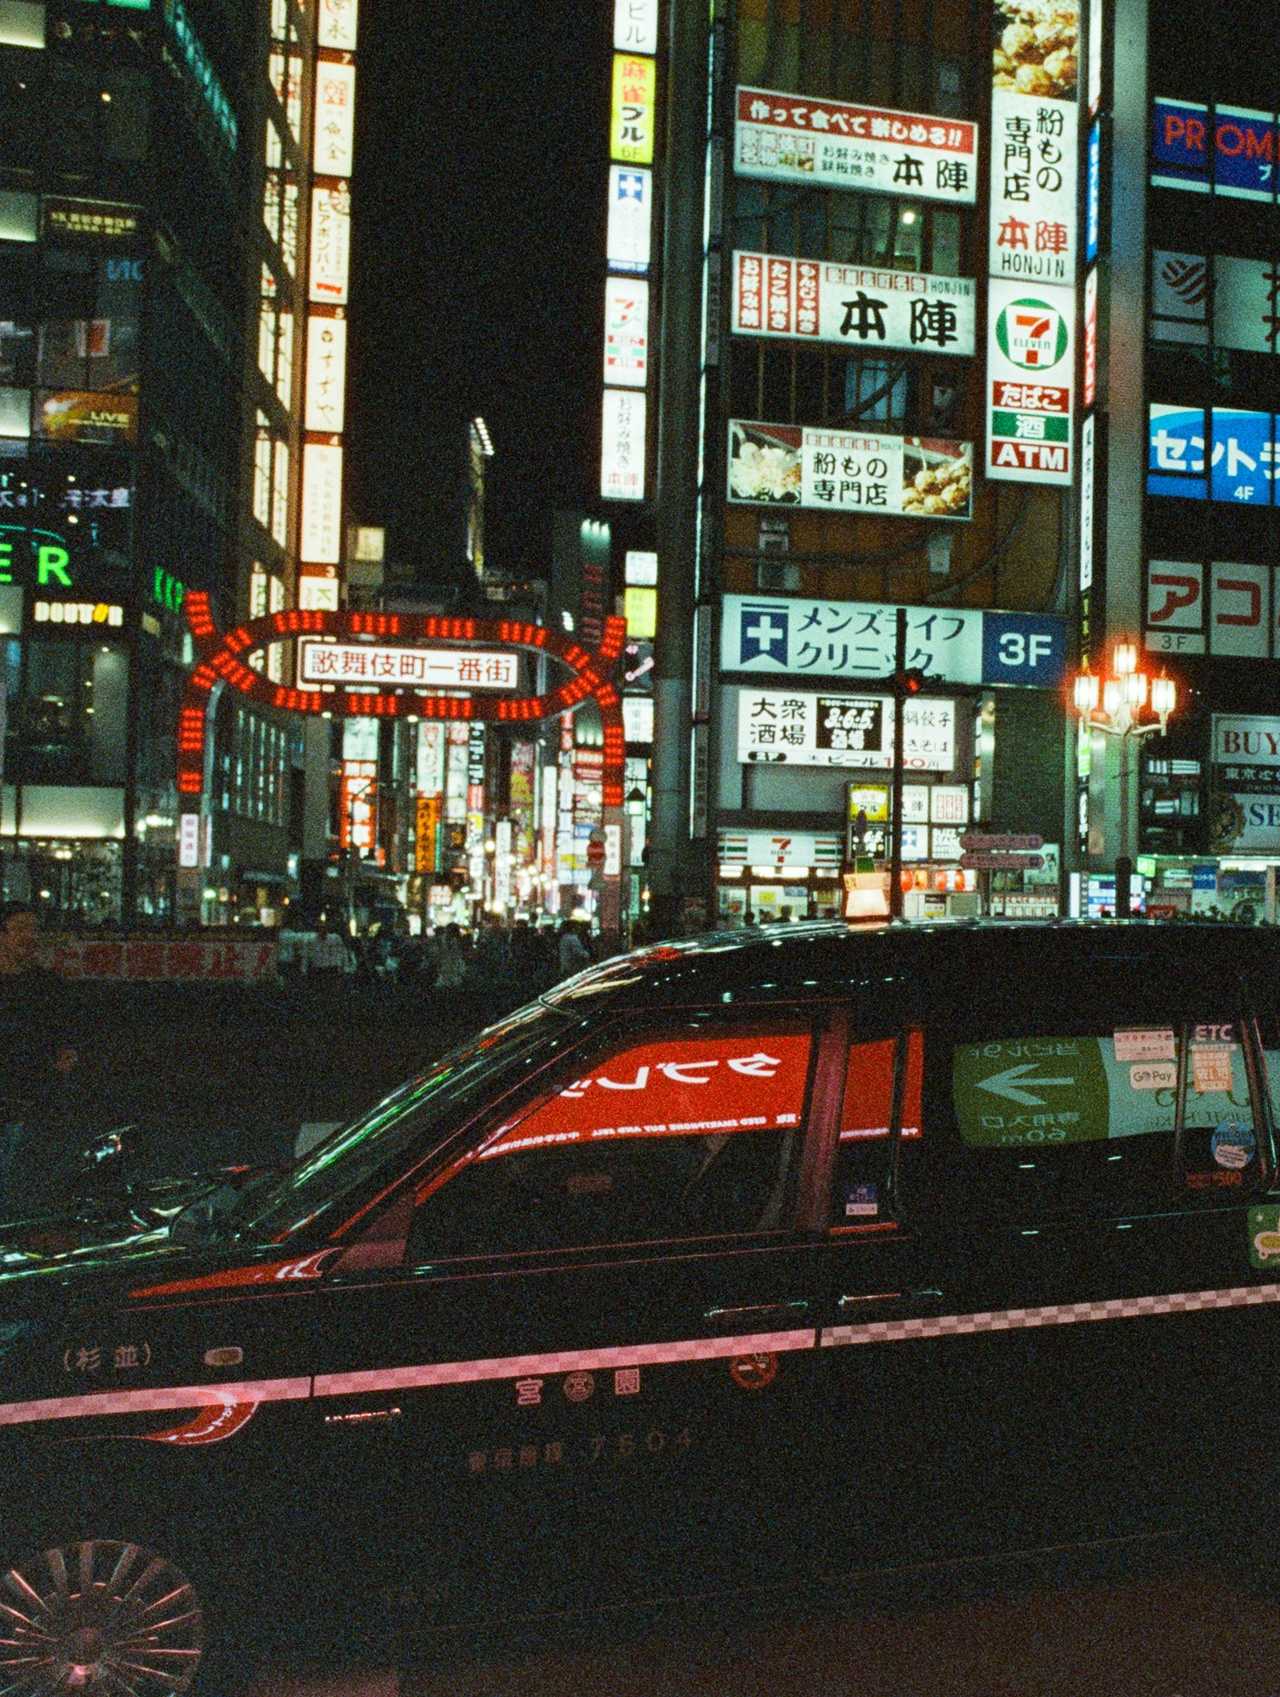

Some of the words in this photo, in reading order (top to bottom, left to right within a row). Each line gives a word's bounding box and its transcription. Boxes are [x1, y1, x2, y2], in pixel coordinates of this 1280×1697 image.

[823, 146, 890, 165] お好み焼き
[1003, 116, 1032, 203] 専門店
[1036, 106, 1065, 193] 粉もの
[892, 153, 969, 193] 本陣
[996, 215, 1069, 255] 本陣
[1001, 252, 1065, 279] HONJIN
[930, 280, 970, 297] HONJIN
[839, 291, 959, 348] 本陣
[1000, 383, 1063, 411] たばこ
[1015, 414, 1047, 439] 酒
[812, 451, 889, 480] 粉もの
[996, 443, 1065, 471] ATM
[812, 479, 889, 507] 専門店
[1233, 485, 1255, 501] 4F
[998, 632, 1053, 668] 3F
[1161, 635, 1188, 650] 3F
[312, 650, 512, 683] 歌舞伎町一番街
[750, 696, 808, 721] 大衆
[750, 723, 807, 746] 酒場
[1194, 1024, 1233, 1041] ETC
[1152, 1069, 1173, 1082] Pay
[514, 1377, 544, 1406] 宮
